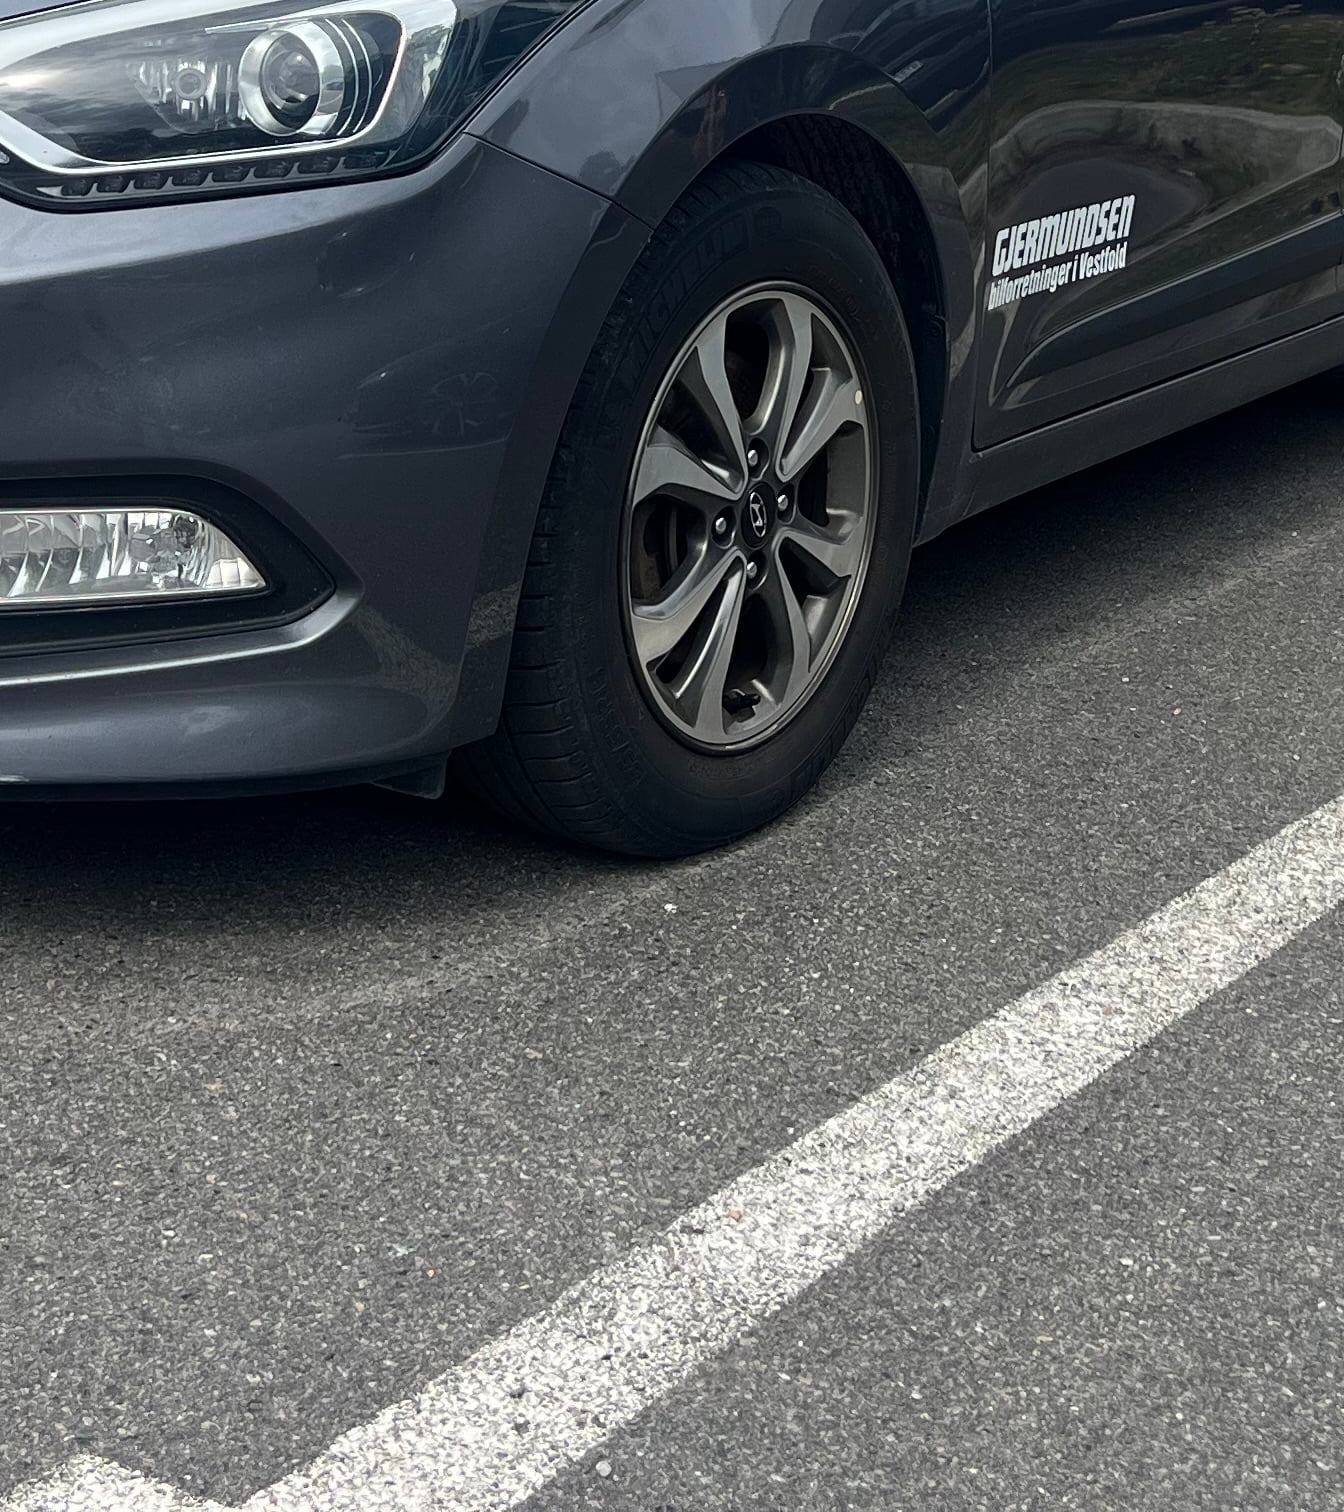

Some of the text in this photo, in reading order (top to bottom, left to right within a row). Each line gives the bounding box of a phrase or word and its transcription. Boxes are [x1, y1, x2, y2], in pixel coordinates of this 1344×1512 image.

[991, 194, 1136, 277] GJERMUNDSEN
[987, 241, 1128, 311] bilforretninger i Vestfold
